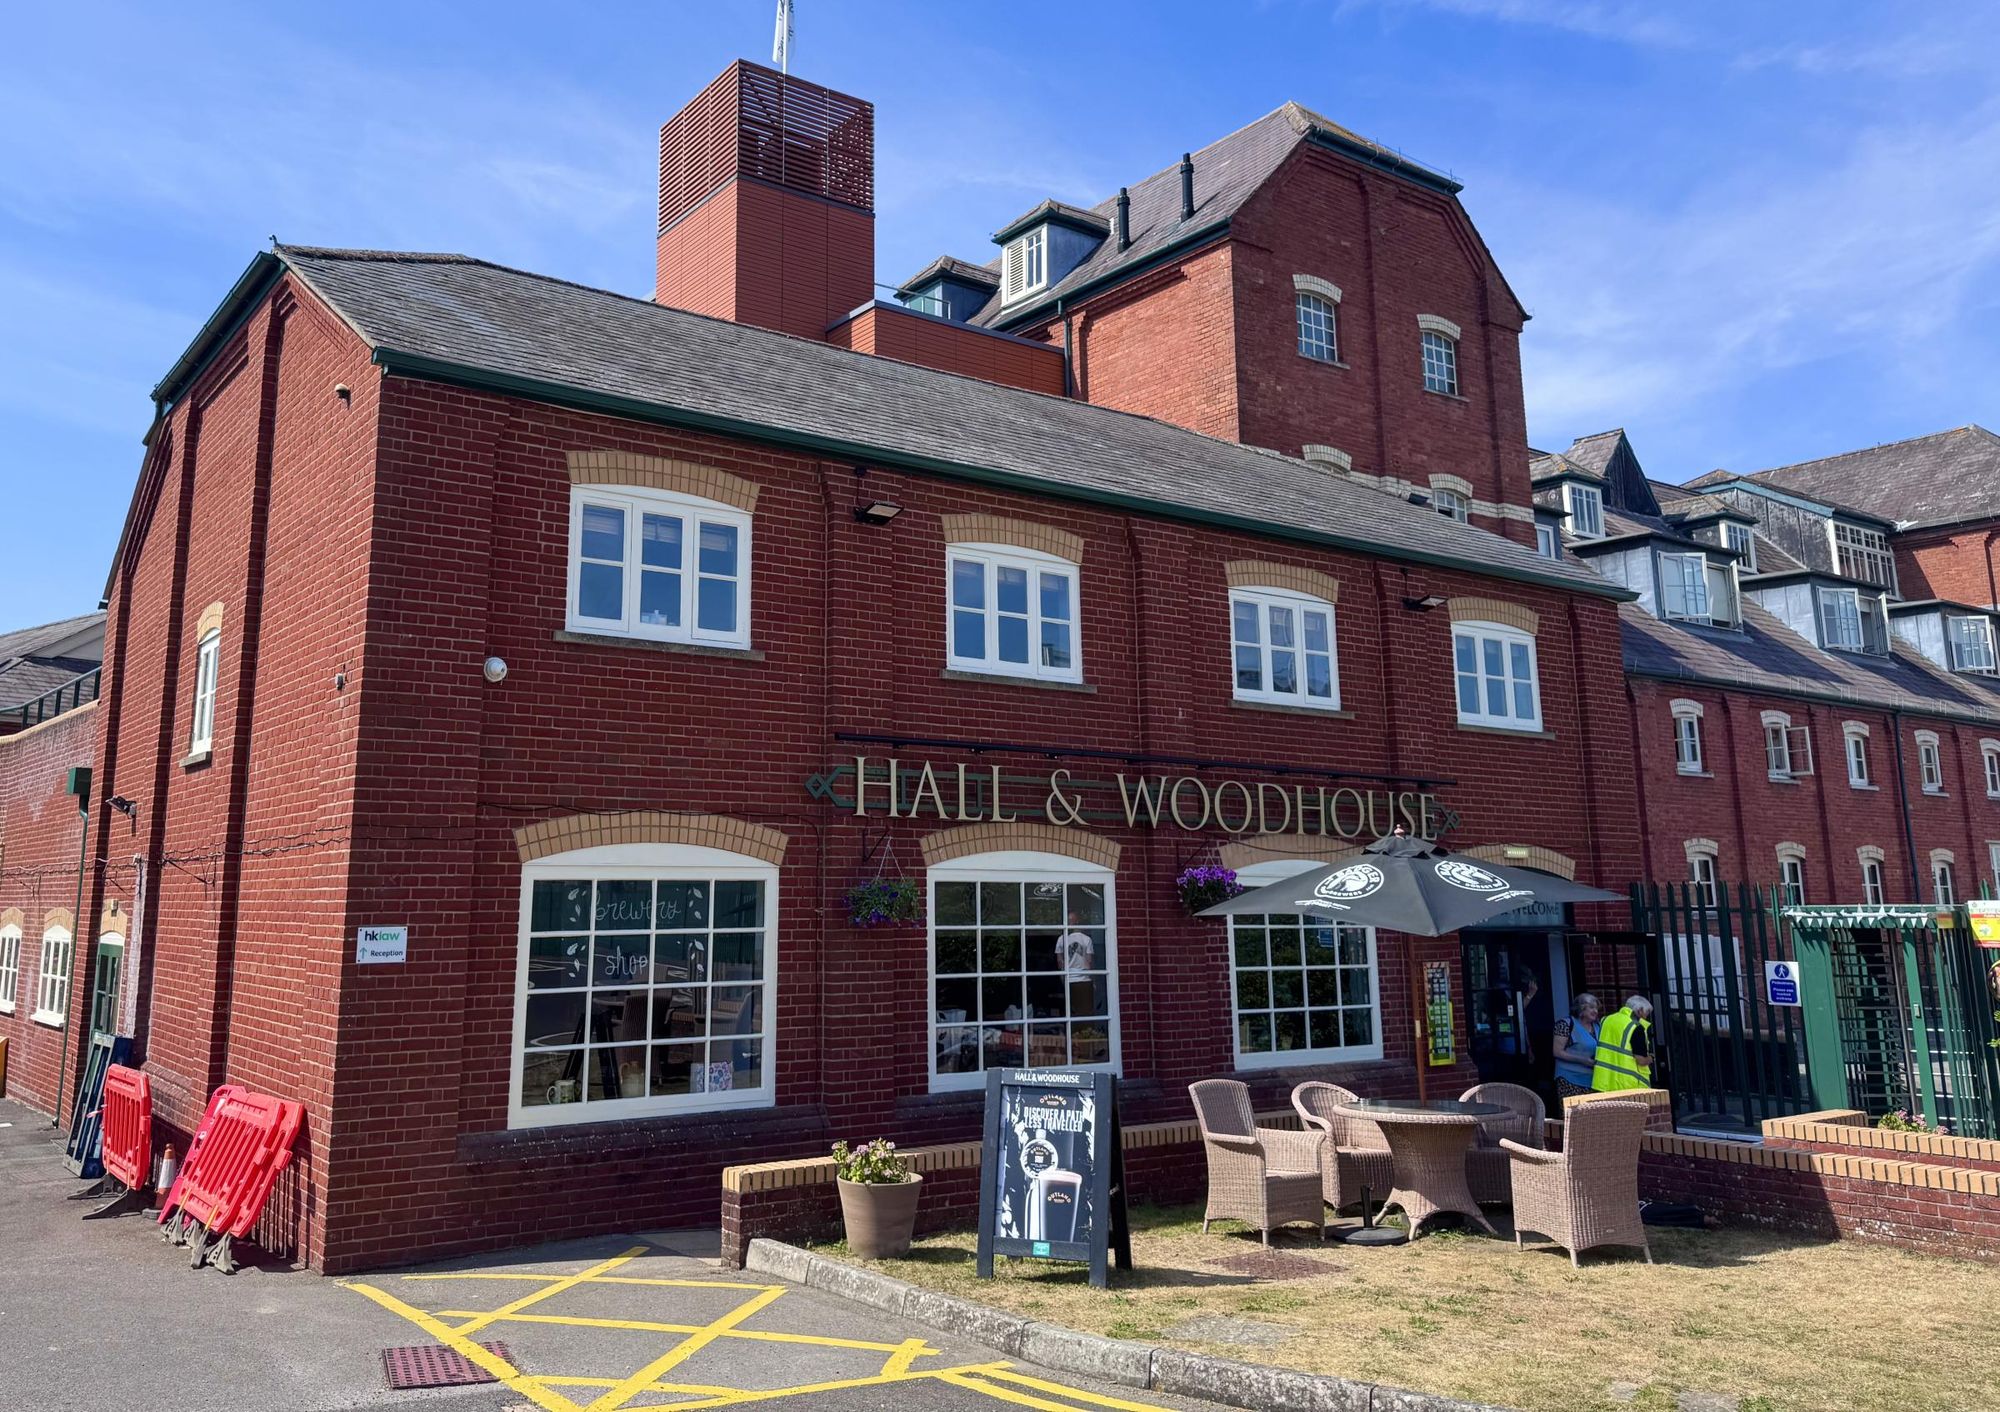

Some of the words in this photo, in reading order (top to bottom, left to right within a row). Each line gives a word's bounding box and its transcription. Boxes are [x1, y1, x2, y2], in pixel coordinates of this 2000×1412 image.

[852, 756, 1017, 823] HALL
[1046, 769, 1090, 827] &
[1116, 773, 1439, 841] WOODHOUSE
[370, 949, 403, 957] Reception
[604, 945, 648, 976] shop
[1023, 1106, 1059, 1120] DISCOVER
[1060, 1109, 1065, 1120] A
[1066, 1110, 1084, 1122] PATH
[1024, 1117, 1042, 1129] LESS
[1043, 1119, 1083, 1133] TRAVELLED
